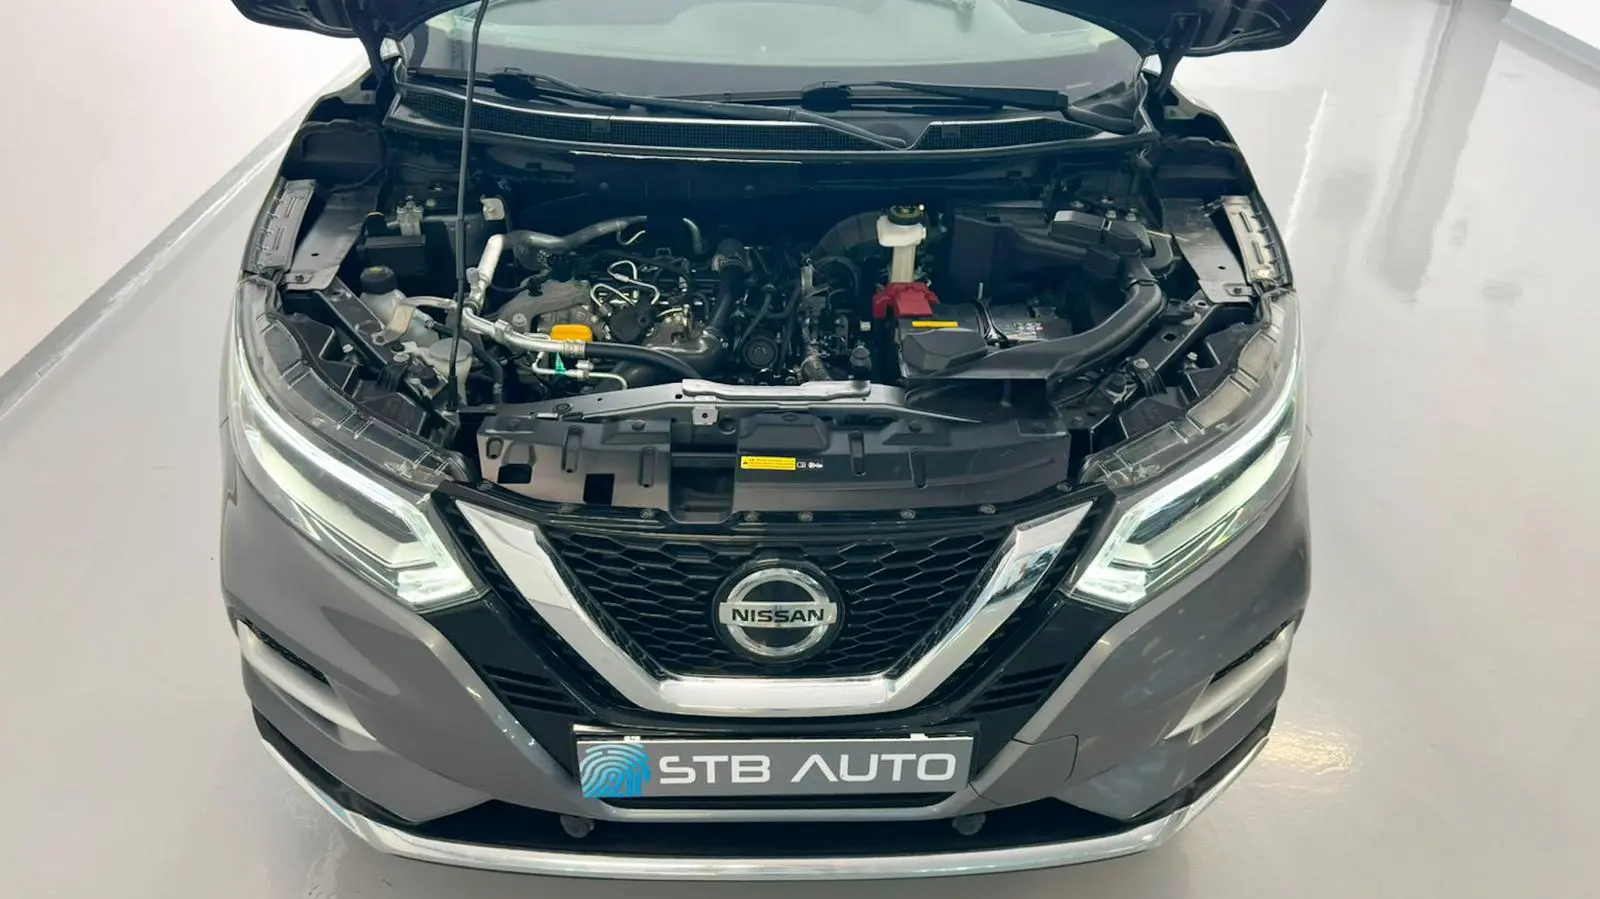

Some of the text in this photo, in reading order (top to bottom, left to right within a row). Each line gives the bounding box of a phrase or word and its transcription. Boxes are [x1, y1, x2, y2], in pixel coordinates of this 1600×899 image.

[731, 608, 825, 623] NISSAN
[659, 752, 956, 784] STB AUTO
